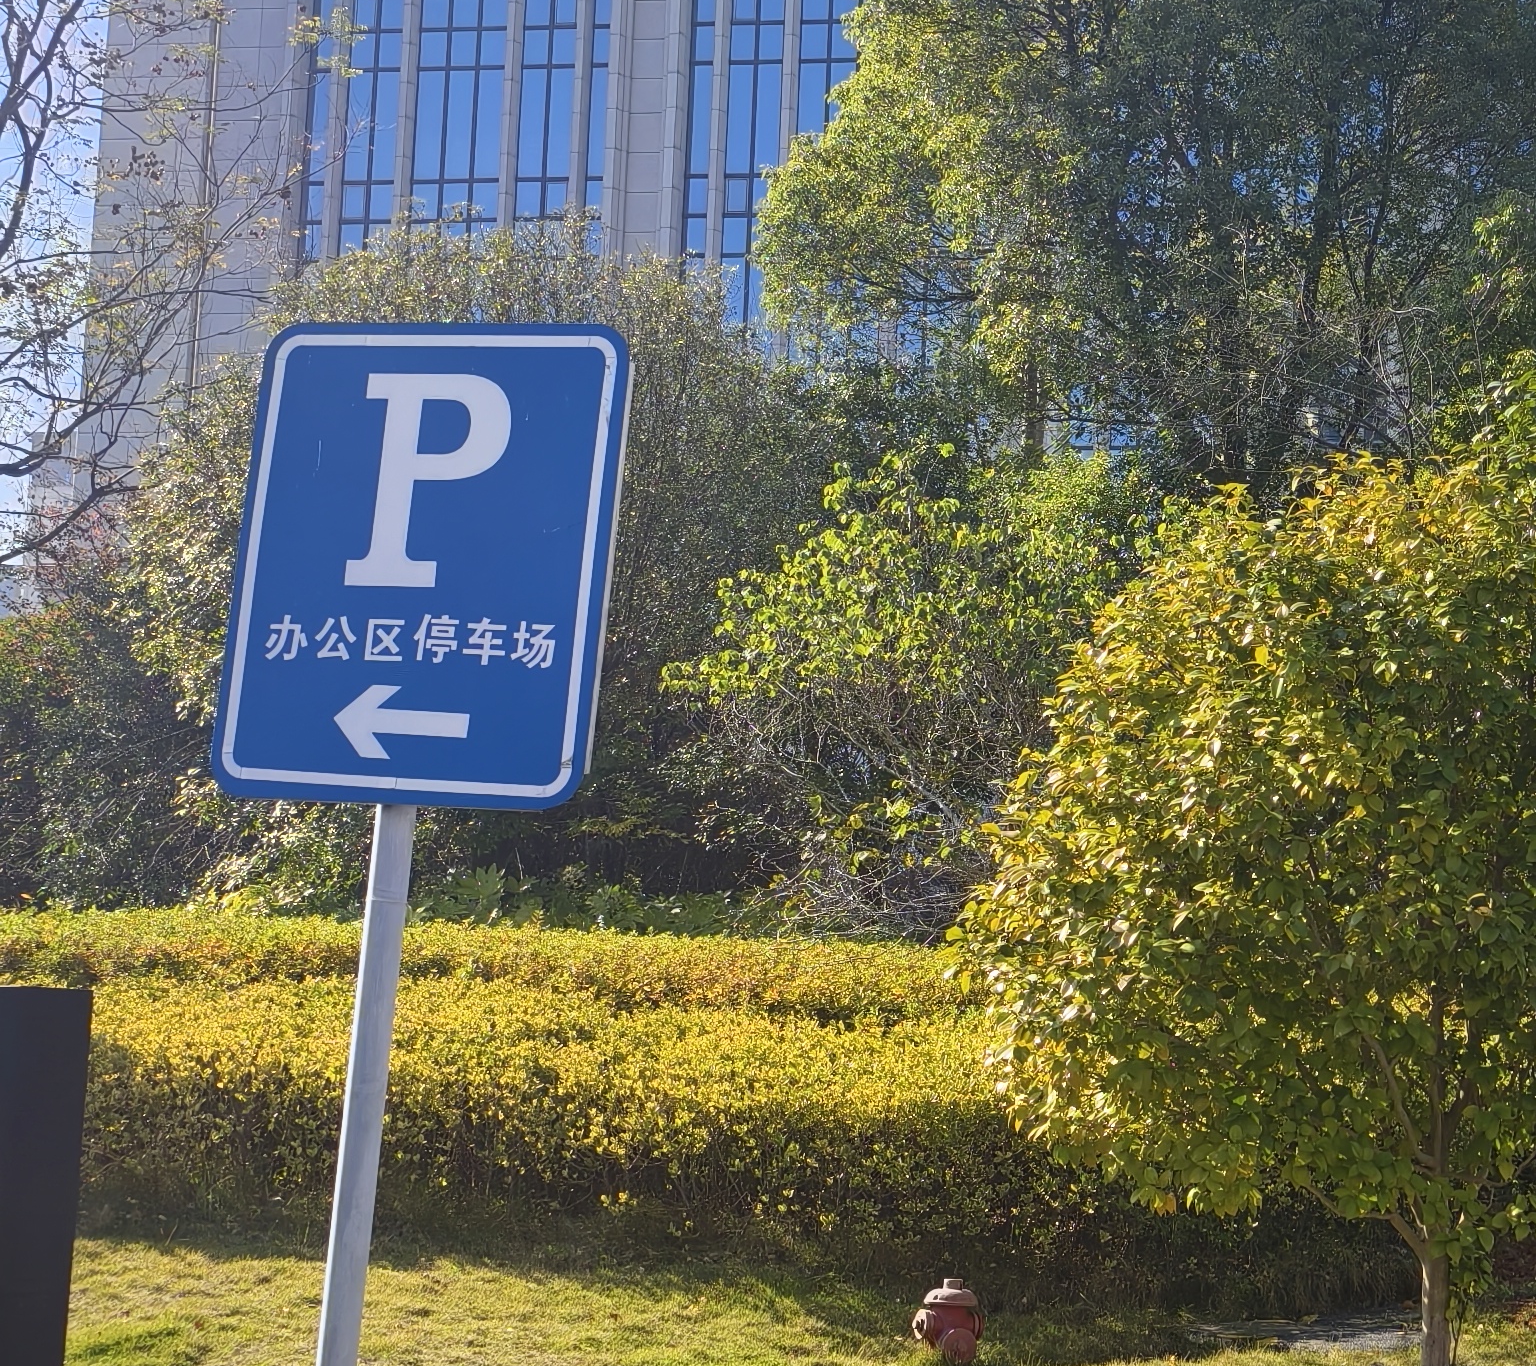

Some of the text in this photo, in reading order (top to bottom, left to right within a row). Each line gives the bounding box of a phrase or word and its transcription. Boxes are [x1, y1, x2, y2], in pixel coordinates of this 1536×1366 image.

[345, 373, 512, 588] P
[264, 614, 556, 669] 办公区停车场
